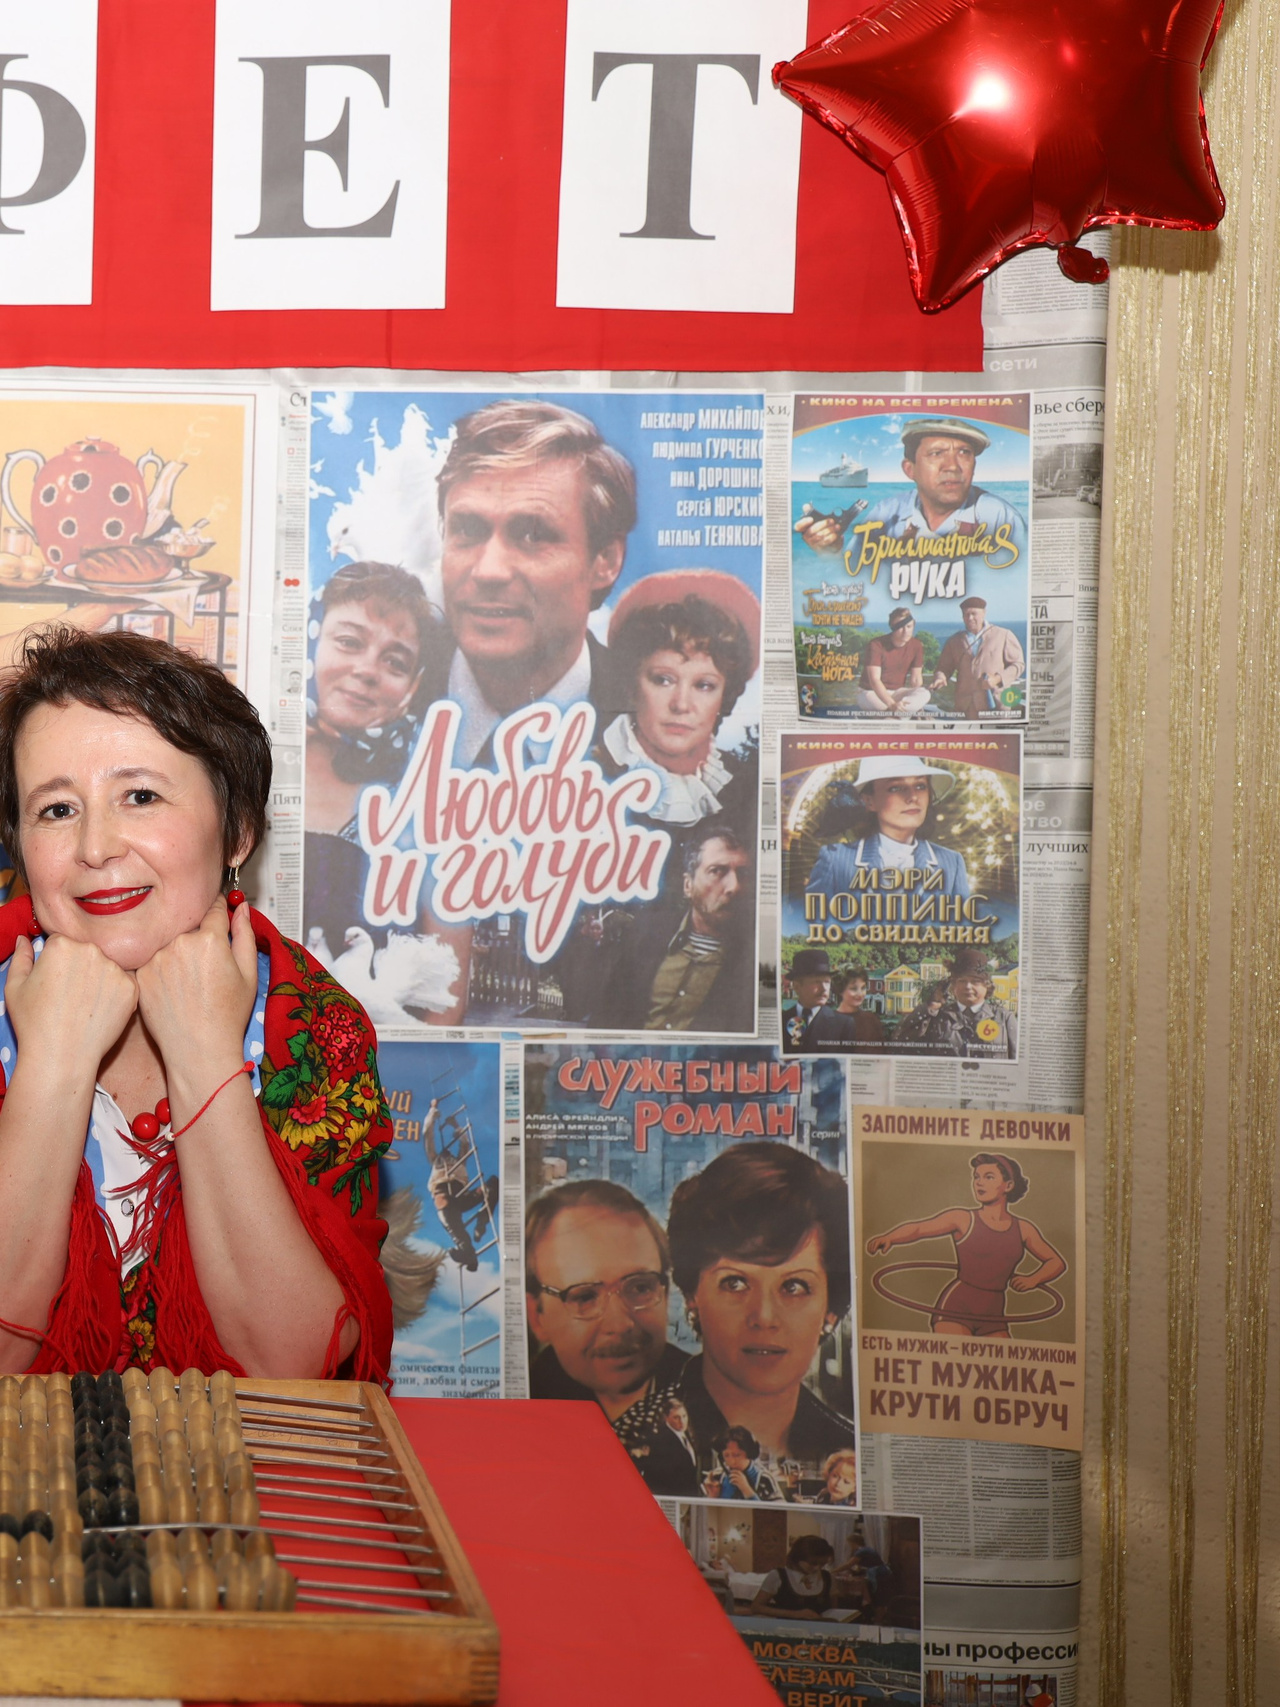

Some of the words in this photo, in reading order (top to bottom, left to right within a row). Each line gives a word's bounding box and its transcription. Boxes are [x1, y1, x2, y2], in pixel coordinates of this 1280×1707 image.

[989, 357, 1038, 372] сети
[810, 397, 858, 407] КИНО
[862, 397, 885, 407] НА
[890, 397, 922, 407] ВСЕ
[926, 397, 1014, 406] ВРЕМЕНА
[640, 412, 696, 432] АЛЕКСАНДР
[652, 441, 703, 460] ЛЮДМИЛА
[705, 437, 765, 460] ГУРЧЕНКО
[670, 470, 696, 488] НИНА
[697, 466, 764, 491] ДОРОШИНА
[676, 498, 712, 517] СЕРГЕЙ
[714, 493, 764, 518] ЮРСКИЙ
[657, 529, 701, 547] НАТАЛЬЯ
[704, 525, 764, 547] ТЕНЯКОВА
[889, 560, 966, 605] РУКА
[797, 741, 844, 750] КИНО
[851, 741, 874, 750] НА
[878, 741, 909, 750] ВСЕ
[914, 741, 999, 750] ВРЕМЕНА
[366, 708, 605, 847] Любовь
[1026, 841, 1089, 855] лучших
[372, 853, 417, 918] и
[441, 777, 663, 954] голуби
[849, 867, 945, 891] МЭРИ
[804, 892, 999, 925] ПОППИНС,
[806, 924, 843, 944] ДО
[855, 923, 991, 945] СВИДАНИЯ
[983, 1023, 997, 1036] 6+
[634, 1100, 797, 1153] РОМАН
[862, 1114, 970, 1138] ЗАПОМНИТЕ
[980, 1119, 1071, 1142] ДЕВОЧКИ
[862, 1335, 893, 1351] ЕСТЬ
[897, 1337, 949, 1355] МУЖИК
[961, 1340, 1004, 1359] КРУТИ
[1008, 1345, 1077, 1365] МУЖИКОМ
[392, 1363, 456, 1375] омическая
[423, 1376, 457, 1386] любви
[874, 1357, 922, 1383] НЕТ
[870, 1389, 961, 1421] КРУТИ
[973, 1396, 1069, 1431] ОБРУЧ
[753, 1640, 859, 1665] МОСКВА
[956, 1641, 1080, 1665] професси
[787, 1690, 869, 1707] ВЕРИТ
